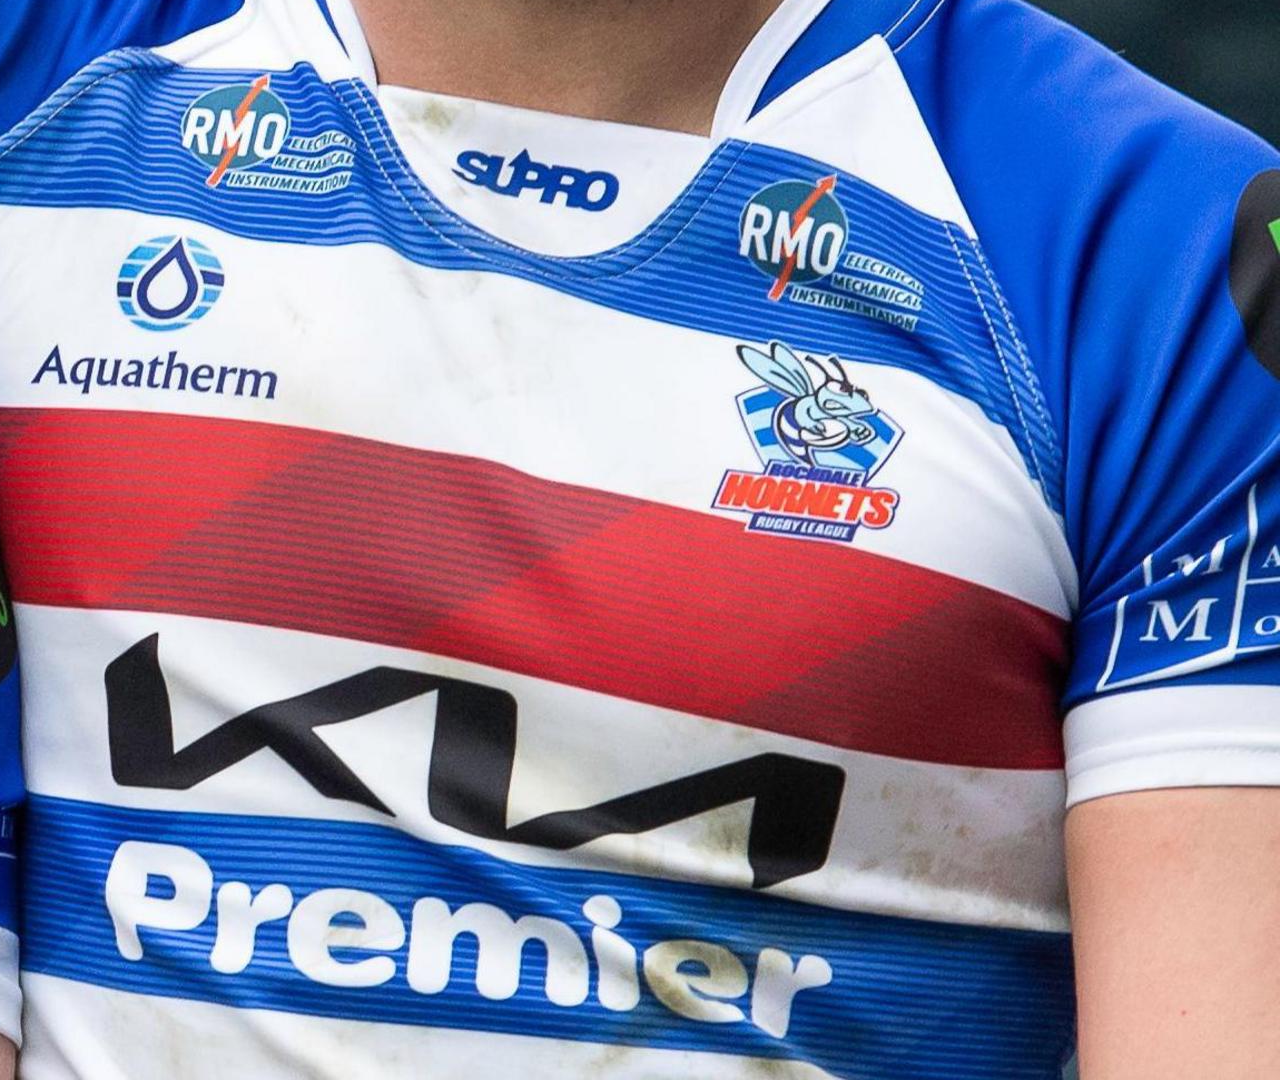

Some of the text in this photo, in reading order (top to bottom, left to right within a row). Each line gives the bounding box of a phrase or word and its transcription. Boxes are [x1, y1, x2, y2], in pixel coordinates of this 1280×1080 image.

[182, 108, 288, 159] RMO
[291, 131, 356, 151] ELECTRICAL
[228, 172, 351, 193] INSTRUMENTATION
[273, 153, 353, 170] MECHANICAL
[451, 148, 619, 212] SUPRO
[740, 203, 844, 275] RMO
[833, 273, 921, 309] MECHANICAL
[844, 254, 924, 294] ELECTRICAL
[792, 287, 916, 331] INSTRUMENTATION
[31, 344, 278, 400] Aquatherm
[768, 462, 863, 487] ROCHDALE
[718, 473, 894, 527] HORNETS
[755, 515, 852, 539] RUGBY LEAGUE
[105, 633, 846, 889] KIA
[104, 840, 834, 1039] Premier
